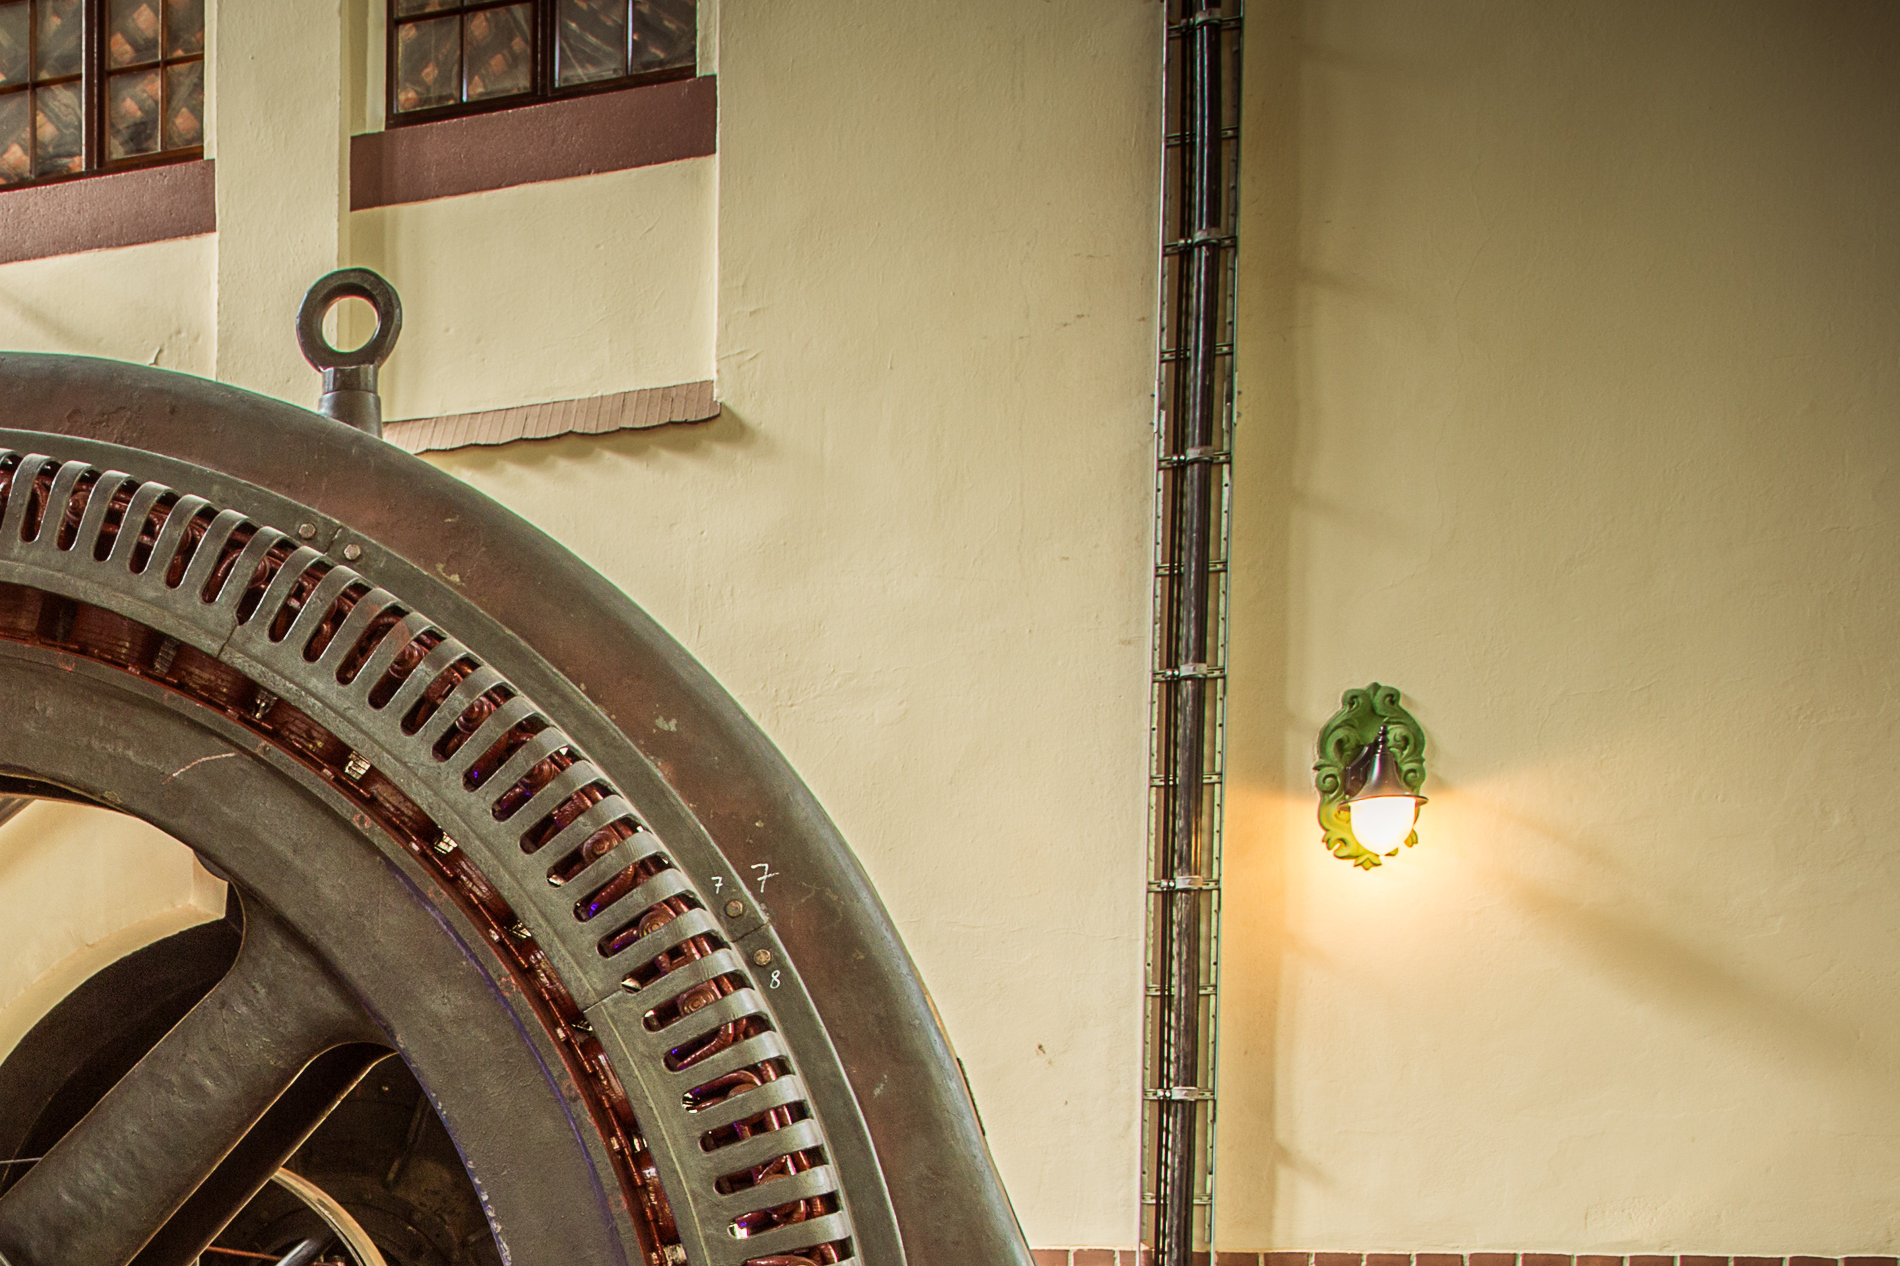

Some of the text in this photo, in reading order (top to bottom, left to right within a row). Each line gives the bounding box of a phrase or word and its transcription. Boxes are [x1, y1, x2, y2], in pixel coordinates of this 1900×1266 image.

[711, 876, 724, 894] 7
[750, 863, 780, 893] 7
[769, 969, 781, 989] 8
